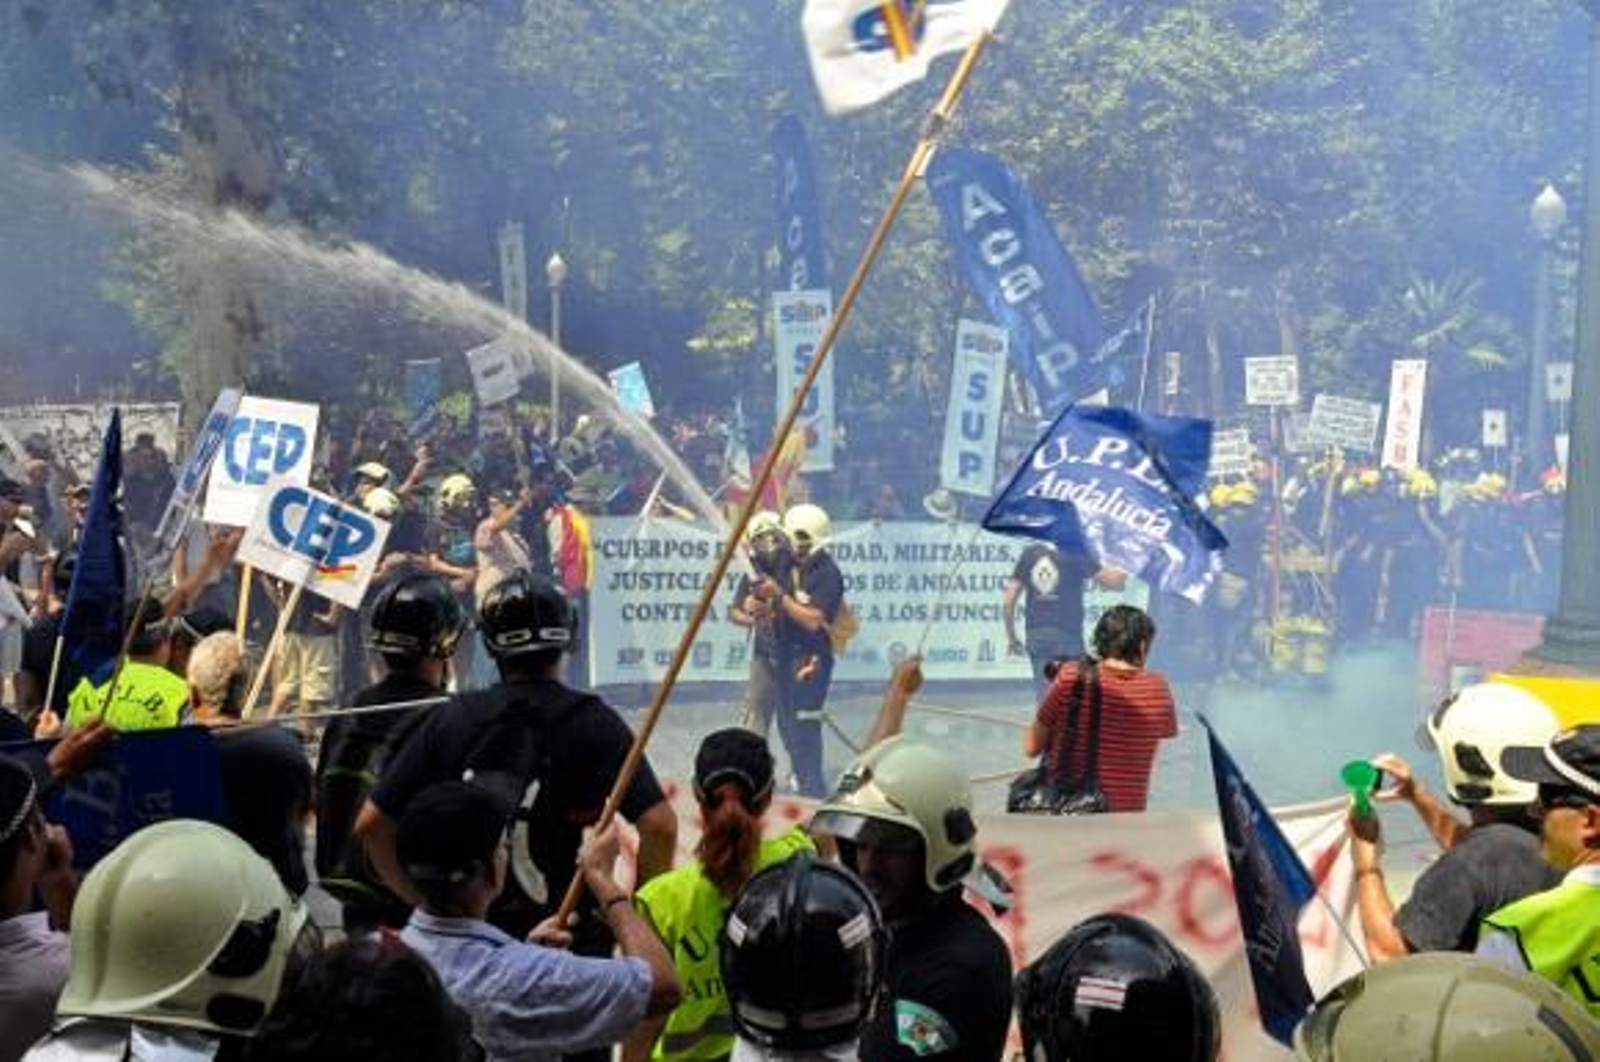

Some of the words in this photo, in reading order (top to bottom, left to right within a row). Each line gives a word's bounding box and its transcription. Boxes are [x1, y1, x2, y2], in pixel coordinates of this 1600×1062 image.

[225, 416, 307, 486] CEP
[957, 371, 989, 480] SUP
[268, 486, 376, 566] CEP
[867, 604, 882, 622] A
[888, 603, 927, 622] LOS
[873, 572, 902, 592] DE
